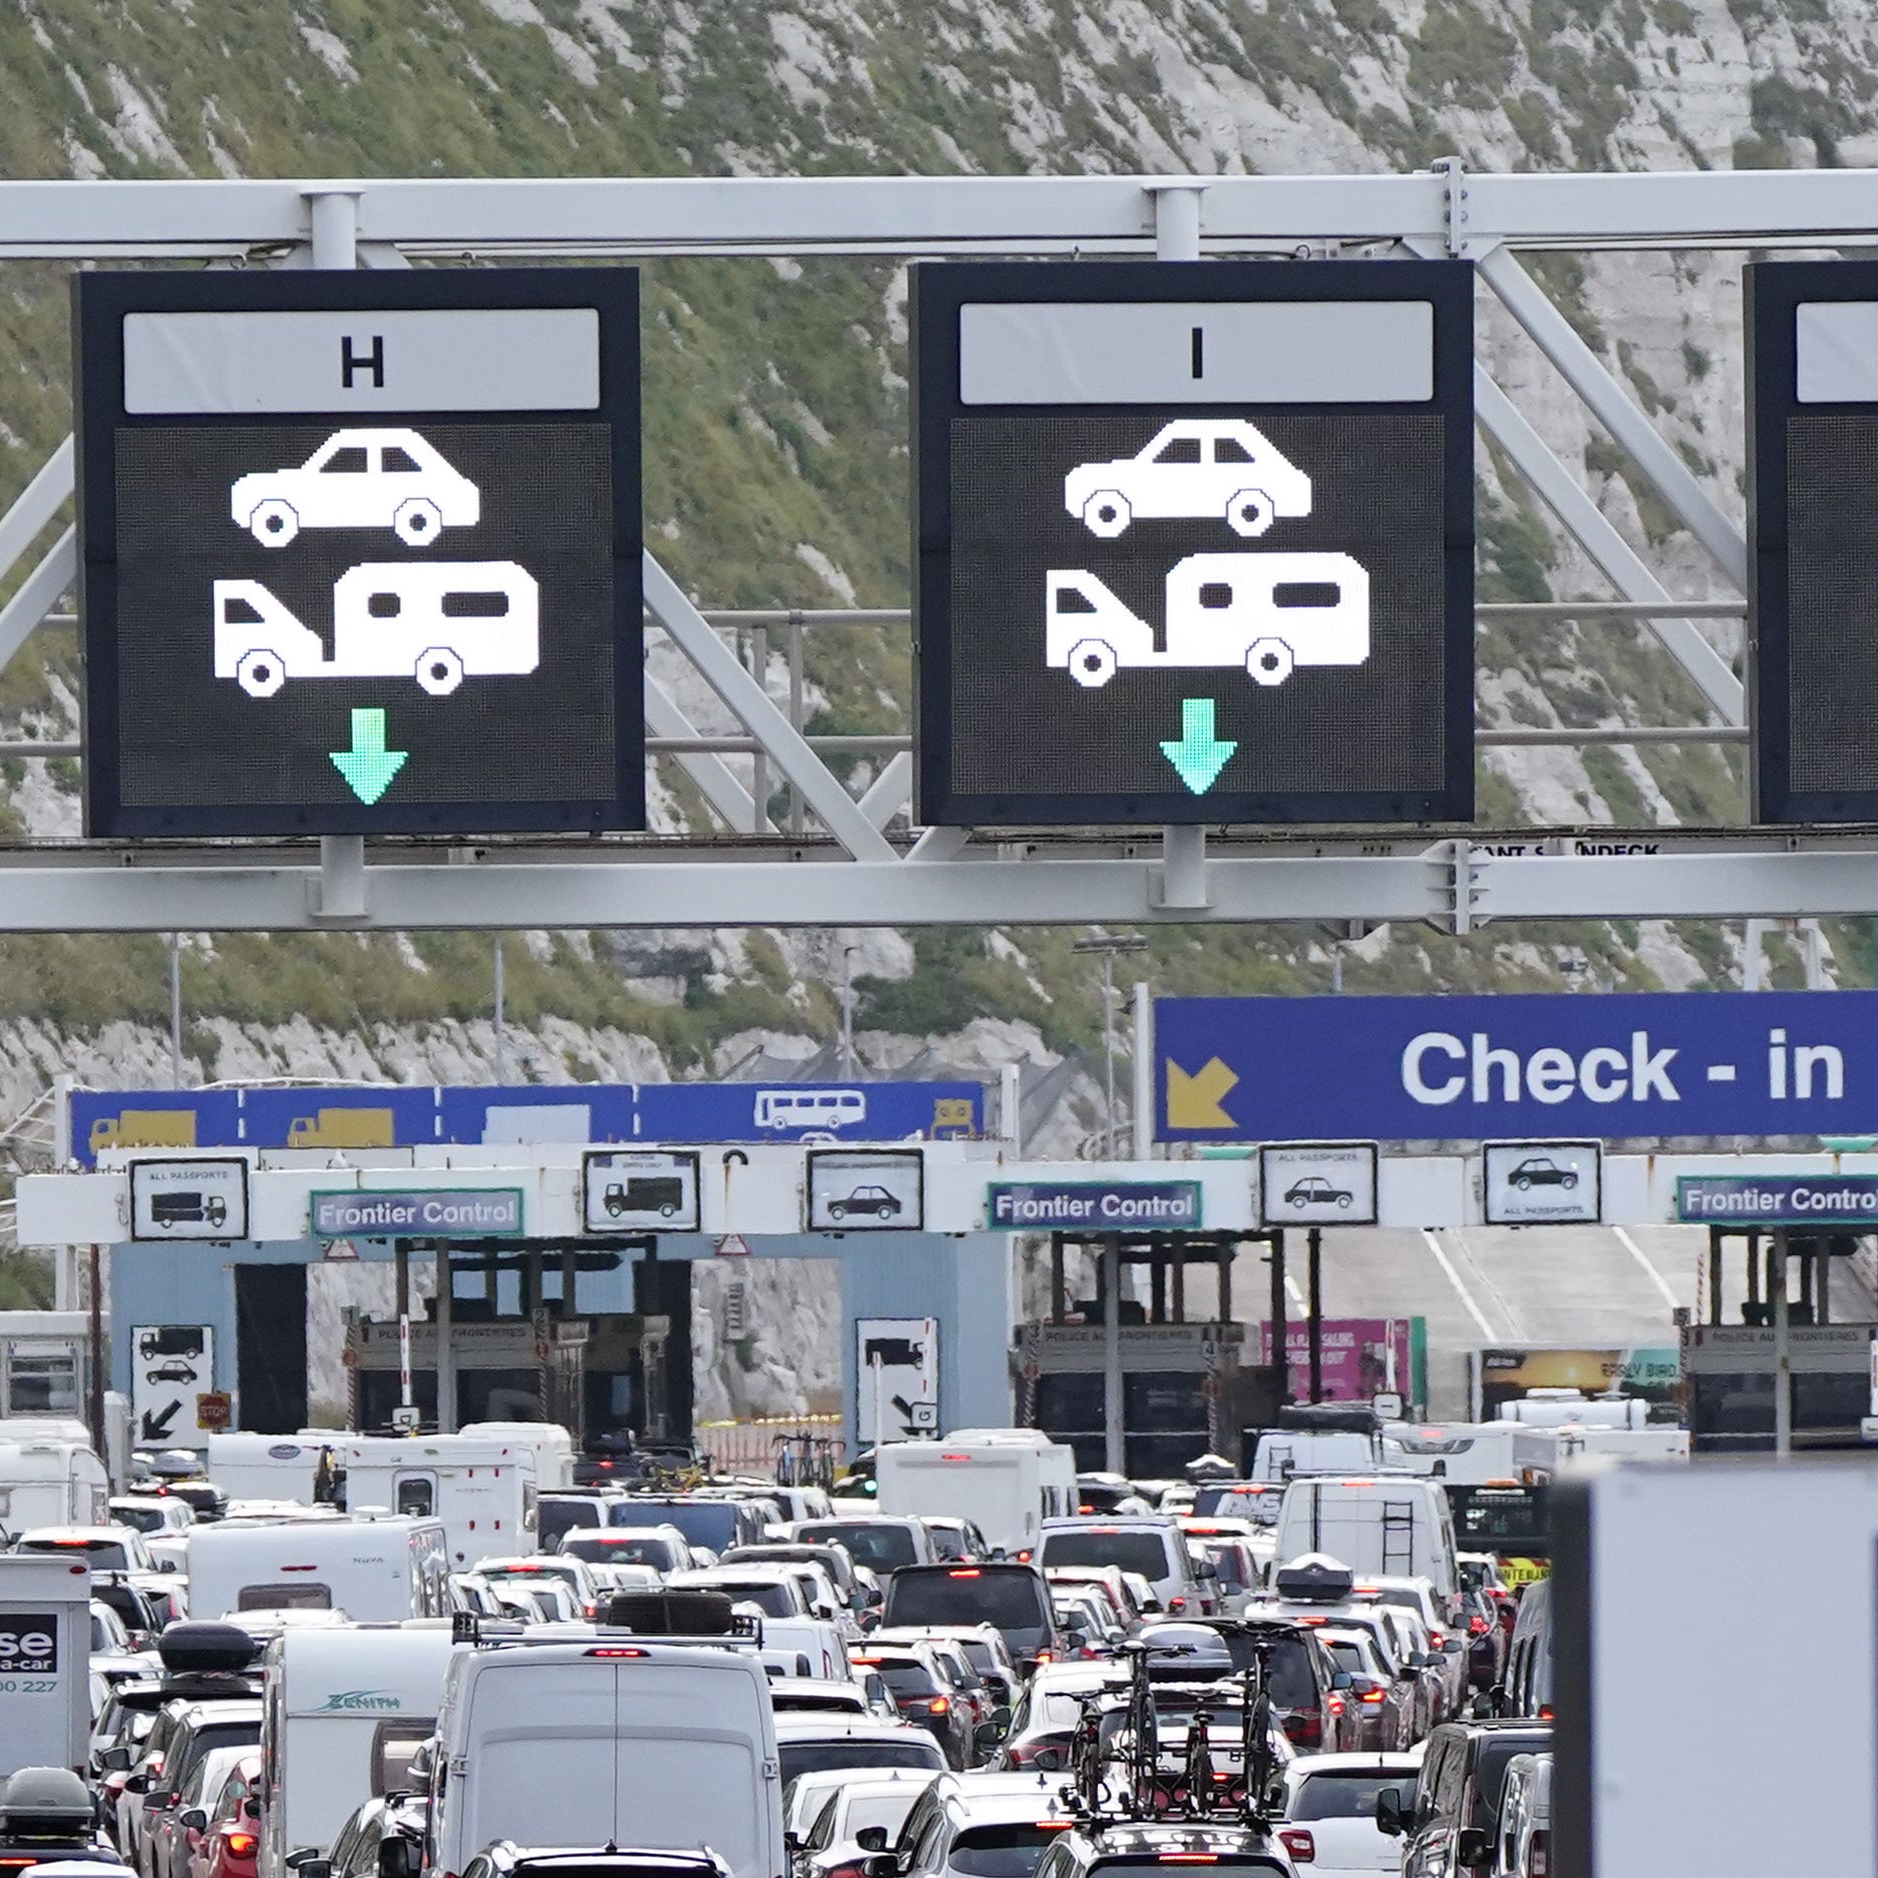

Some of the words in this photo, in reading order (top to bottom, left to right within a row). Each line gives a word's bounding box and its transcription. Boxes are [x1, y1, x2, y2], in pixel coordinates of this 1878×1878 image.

[342, 336, 383, 388] H
[1192, 328, 1202, 378] I
[1402, 1031, 1681, 1105] Check
[1769, 1028, 1844, 1099] in
[149, 1173, 168, 1181] ALL
[170, 1170, 229, 1181] PASSPORTS
[996, 1195, 1095, 1218] Frontier
[1100, 1194, 1192, 1217] Control
[1687, 1188, 1785, 1211] Frontier
[320, 1202, 416, 1226] Frontier
[424, 1200, 516, 1224] Control
[1504, 1208, 1524, 1216] ALL
[199, 1406, 229, 1418] STOP
[22, 1681, 58, 1694] 227
[328, 1694, 400, 1709] ZENITH
